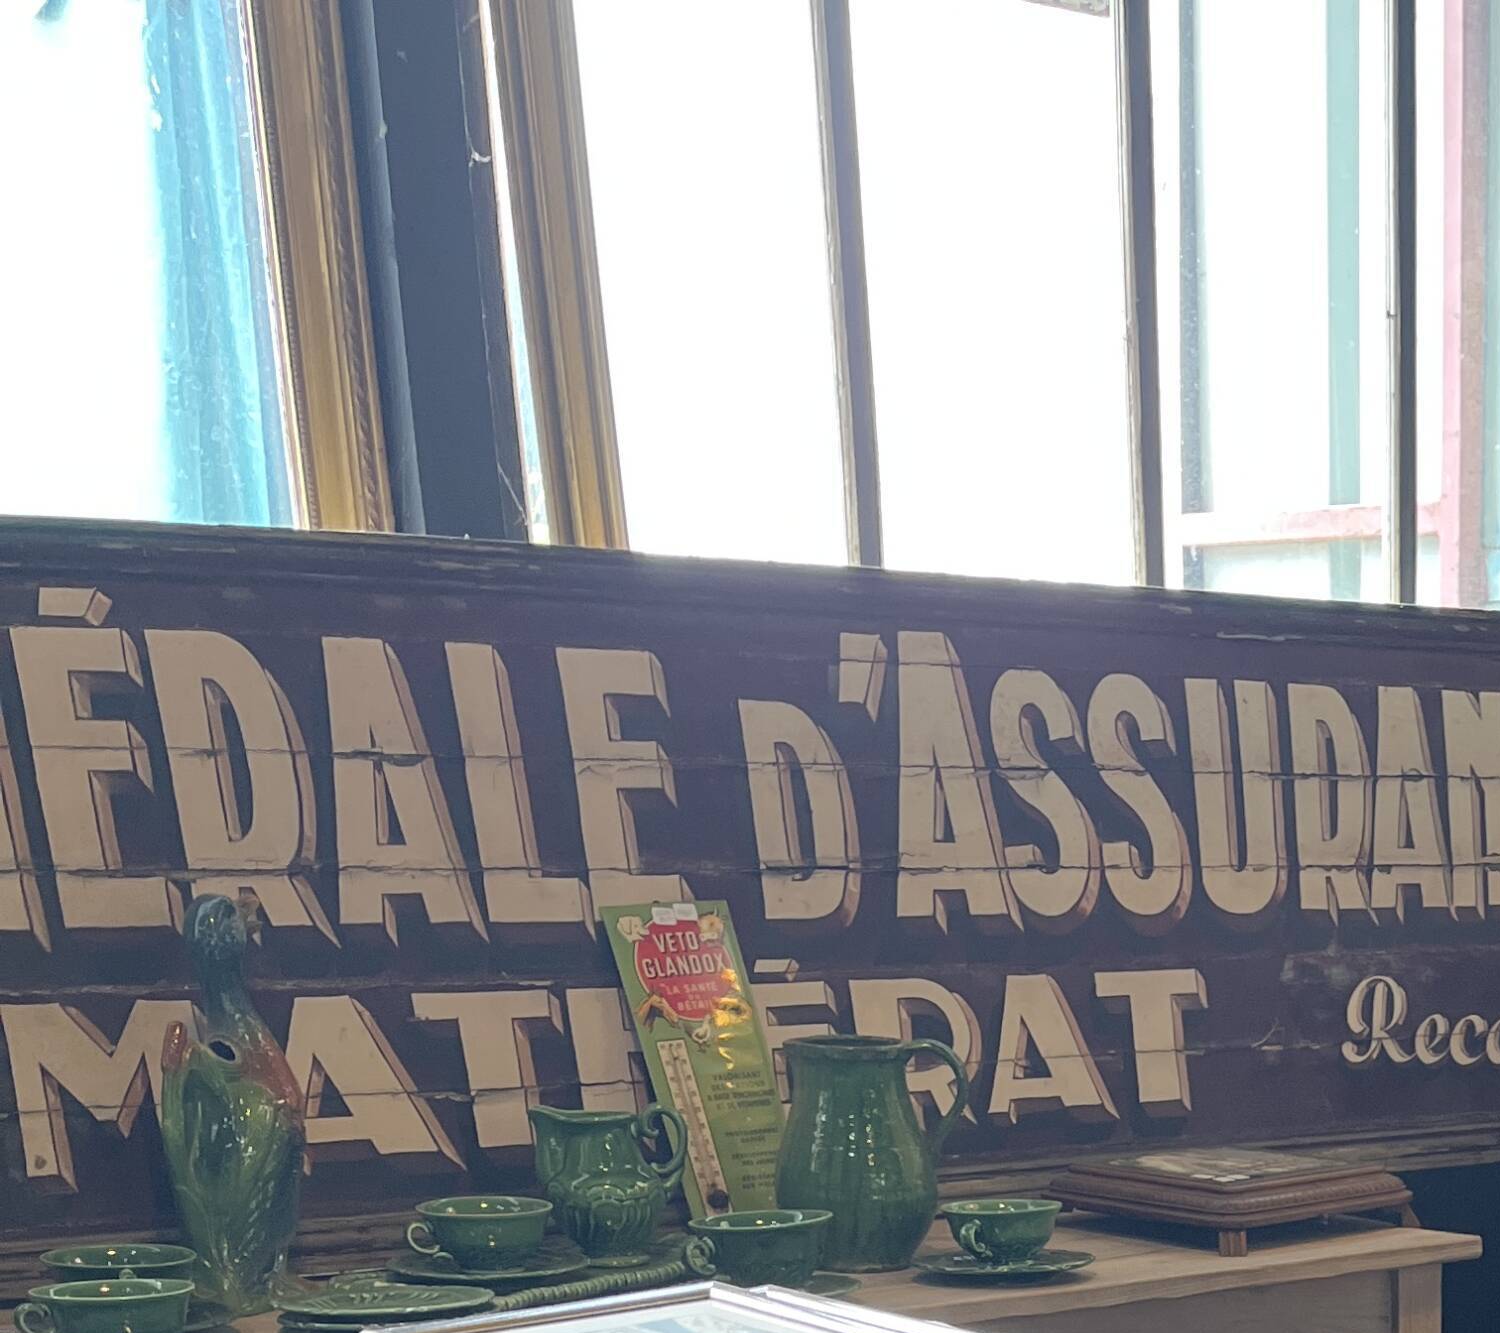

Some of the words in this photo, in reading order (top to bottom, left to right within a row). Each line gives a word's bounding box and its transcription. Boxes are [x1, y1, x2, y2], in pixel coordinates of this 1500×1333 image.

[0, 585, 698, 946] ÉRALE
[652, 931, 699, 953] VETO
[642, 953, 726, 979] GLANDOX
